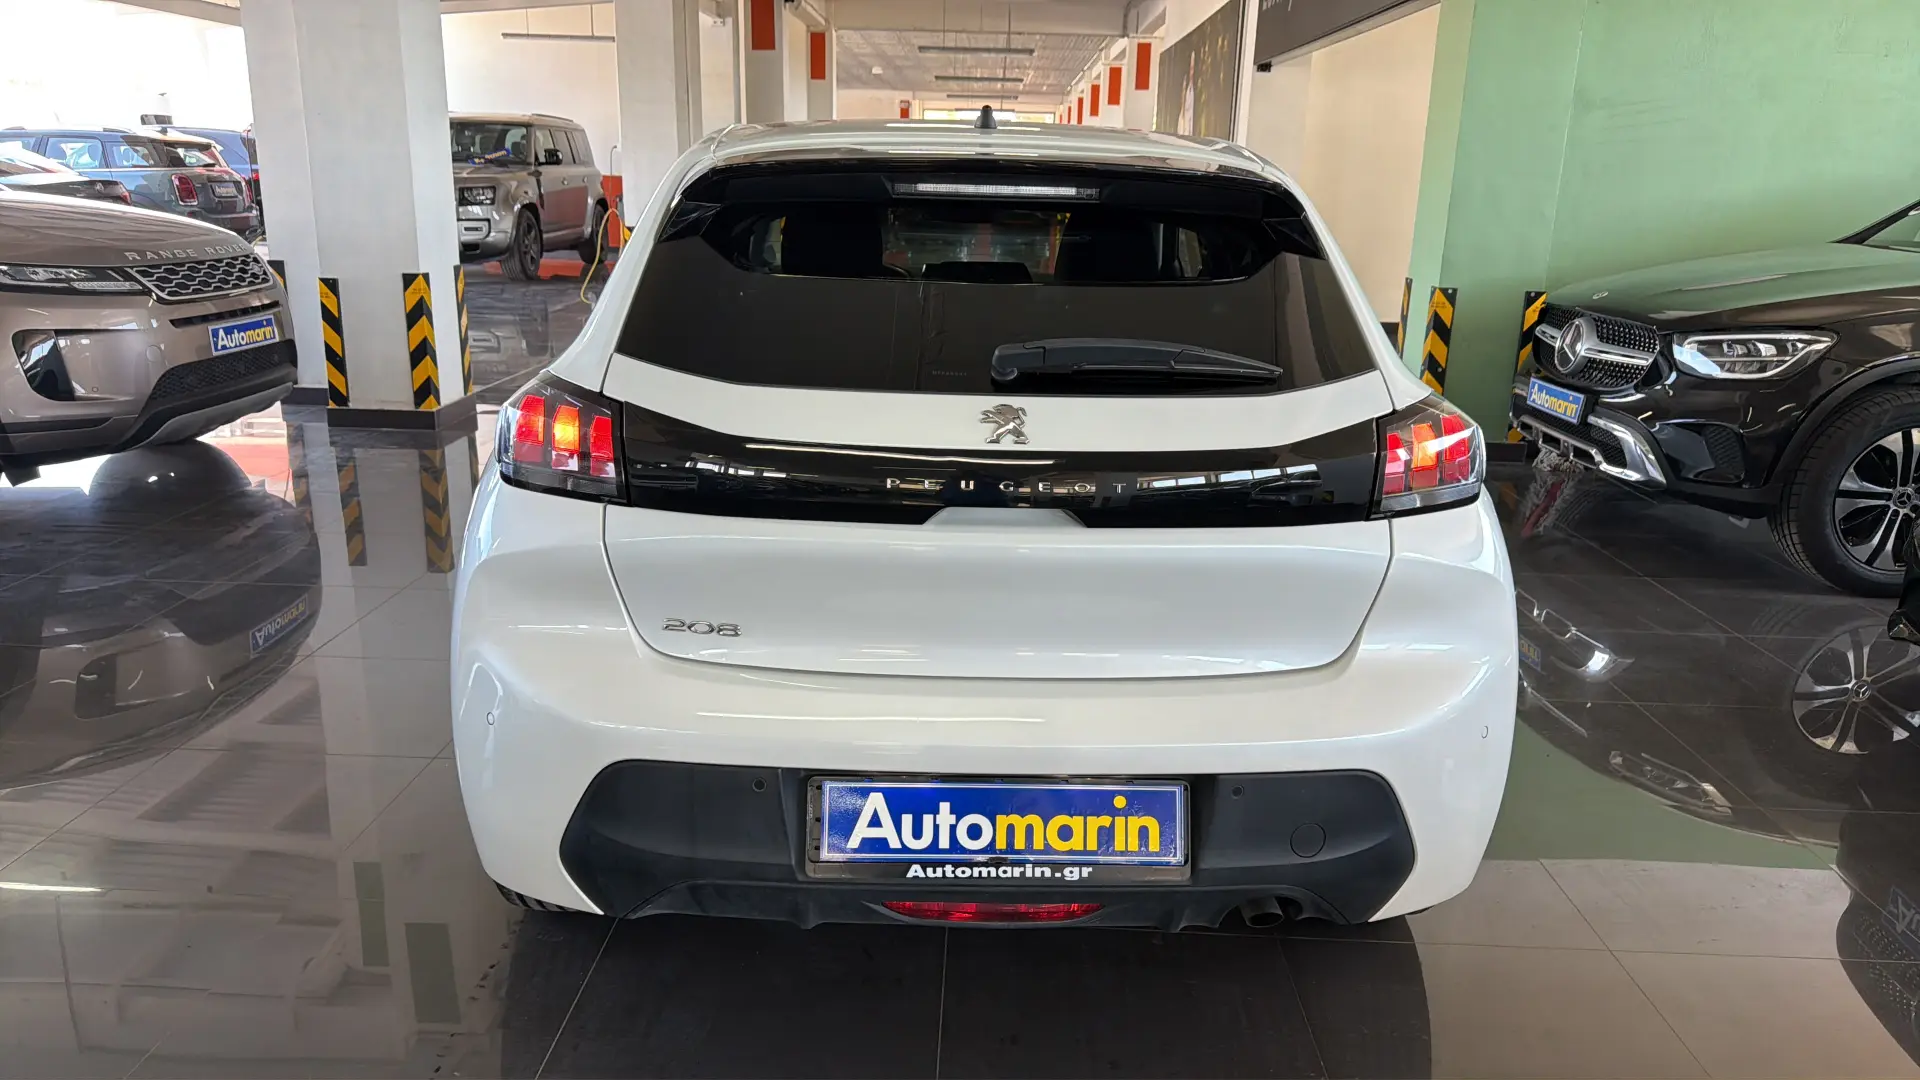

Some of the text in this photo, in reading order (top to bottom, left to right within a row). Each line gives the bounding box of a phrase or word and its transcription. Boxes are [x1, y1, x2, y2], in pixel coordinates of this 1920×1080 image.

[124, 243, 247, 261] RANGE ROVER
[217, 320, 275, 350] Automarin
[1530, 383, 1578, 418] Automarin
[886, 477, 1127, 494] PEUGEOT
[661, 617, 742, 637] 208
[846, 791, 1160, 852] Automarin
[906, 863, 1093, 881] Automarin.gr
